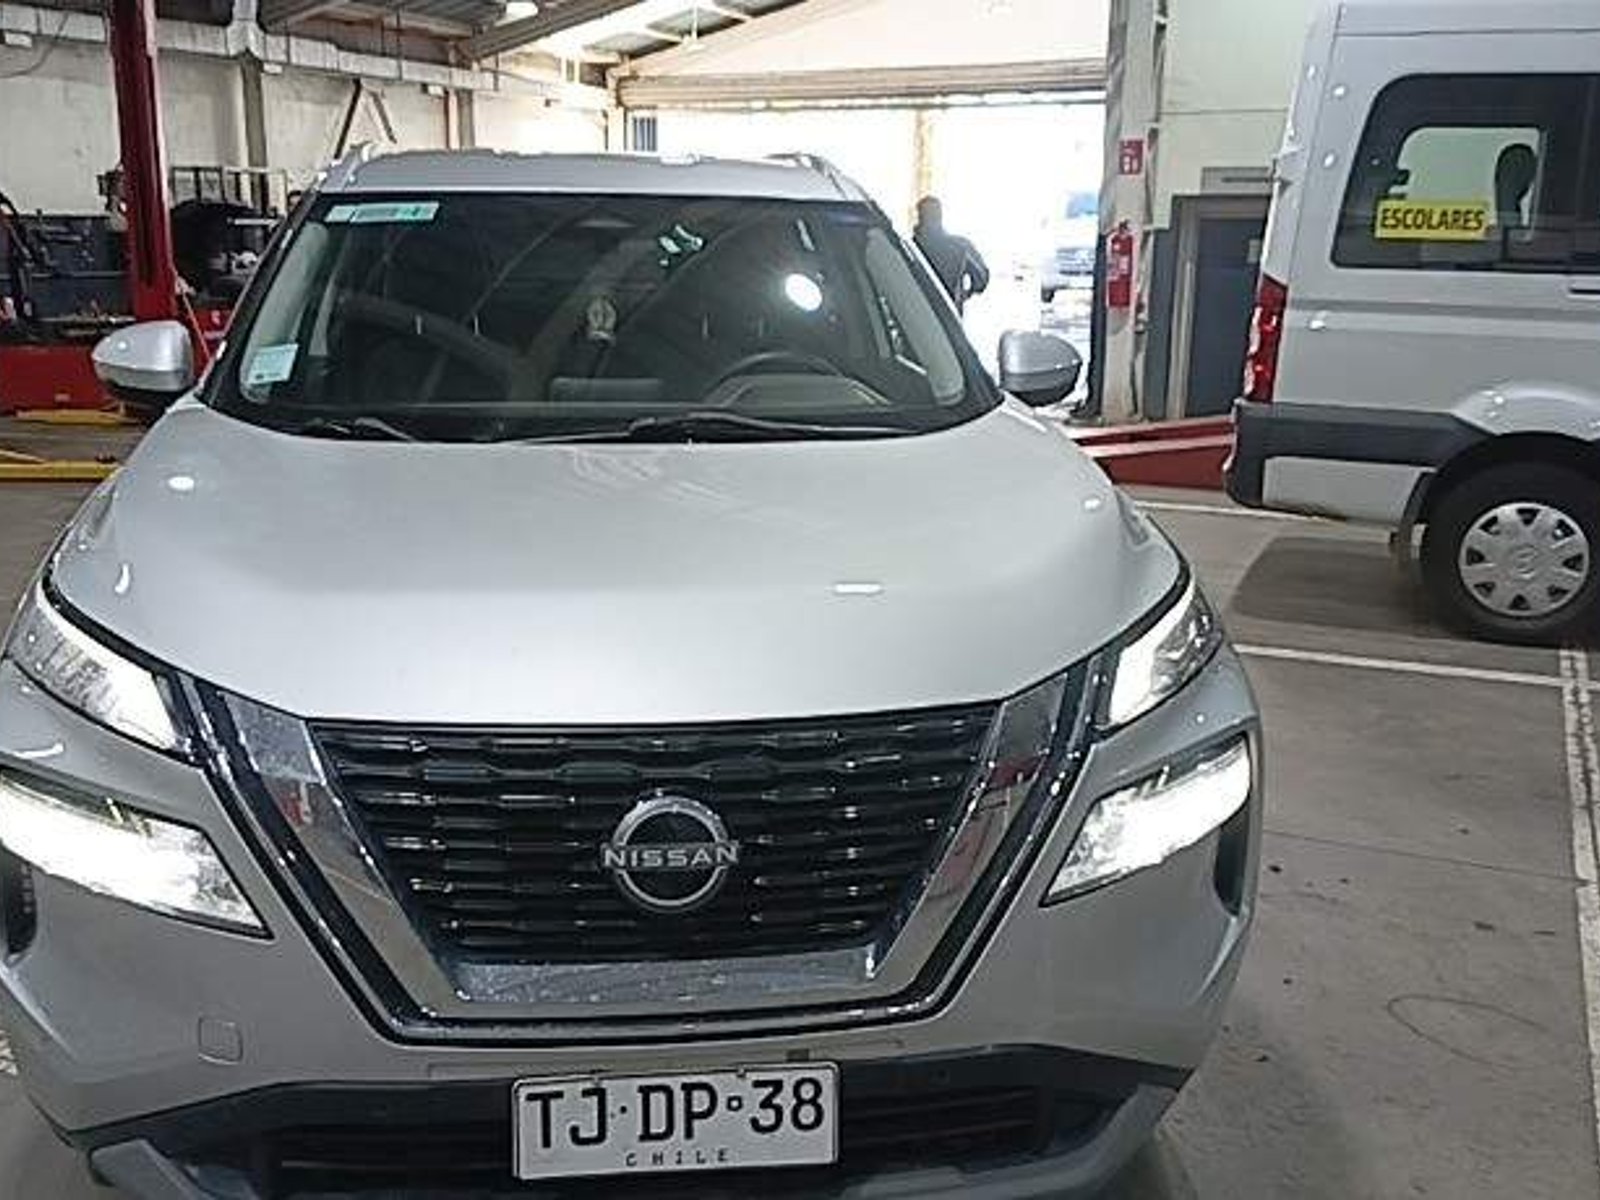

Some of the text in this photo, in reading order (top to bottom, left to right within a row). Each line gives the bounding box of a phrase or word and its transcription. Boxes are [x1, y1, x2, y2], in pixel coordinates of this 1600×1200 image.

[1381, 207, 1485, 231] ESCOLARES
[603, 846, 739, 867] NISSAN
[625, 1148, 730, 1167] CHILE
